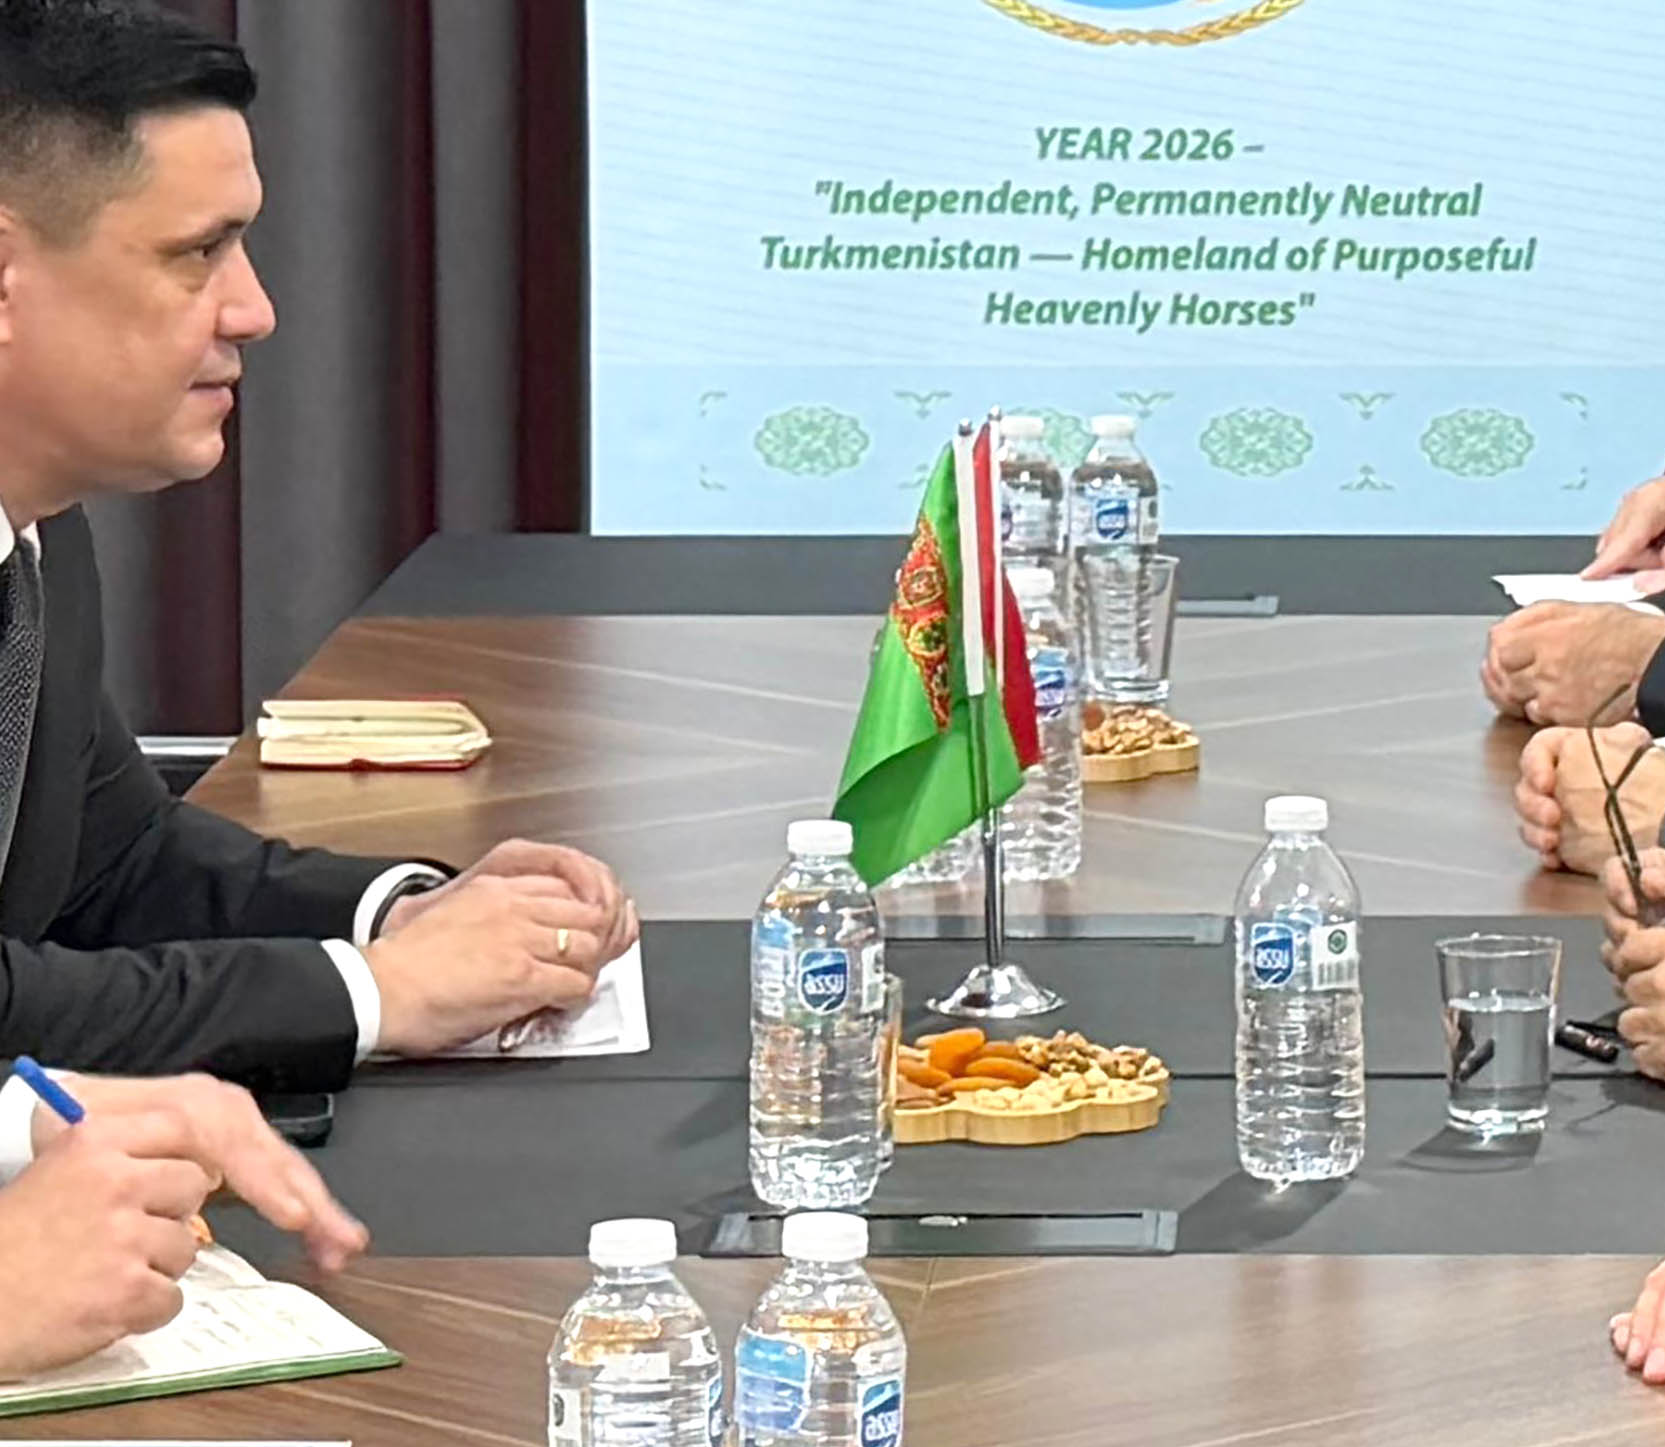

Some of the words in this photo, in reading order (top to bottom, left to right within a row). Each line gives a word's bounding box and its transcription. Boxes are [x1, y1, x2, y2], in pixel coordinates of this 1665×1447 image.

[1035, 126, 1133, 161] YEAR
[1138, 127, 1235, 162] 2026
[815, 179, 1080, 224] "Independent,
[1090, 181, 1335, 226] Permanently
[1339, 181, 1484, 219] Neutral
[760, 234, 1021, 271] Turkmenistan
[1081, 235, 1280, 272] Homeland
[1284, 236, 1331, 272] of
[1332, 236, 1538, 281] Purposeful
[983, 290, 1163, 335] Heavenly
[1168, 291, 1316, 327] Horses"
